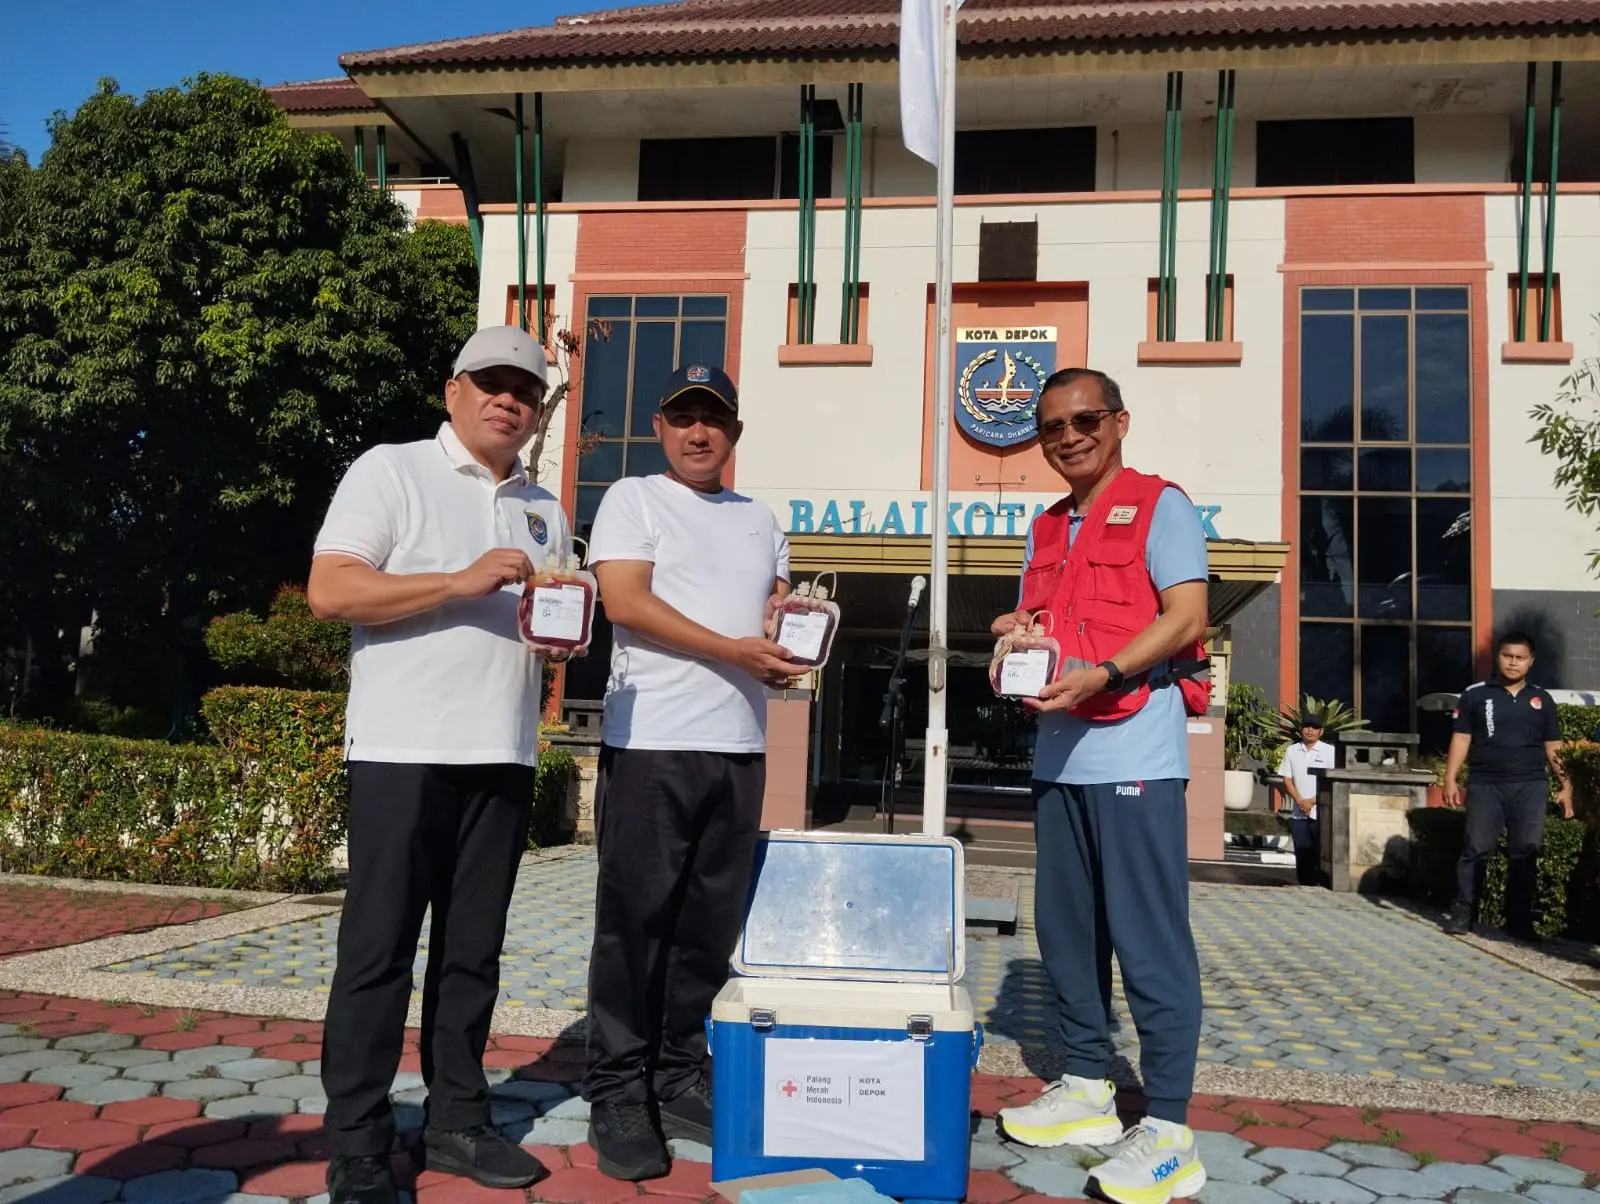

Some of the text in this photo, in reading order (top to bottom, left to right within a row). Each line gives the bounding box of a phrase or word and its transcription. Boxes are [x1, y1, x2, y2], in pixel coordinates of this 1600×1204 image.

[965, 330, 1048, 340] KOTA DEPOK
[1115, 785, 1141, 797] PUMA
[806, 1075, 831, 1084] Palang
[806, 1086, 829, 1094] Merah
[806, 1096, 842, 1104] Indonesia
[1152, 1156, 1179, 1181] HOKA
